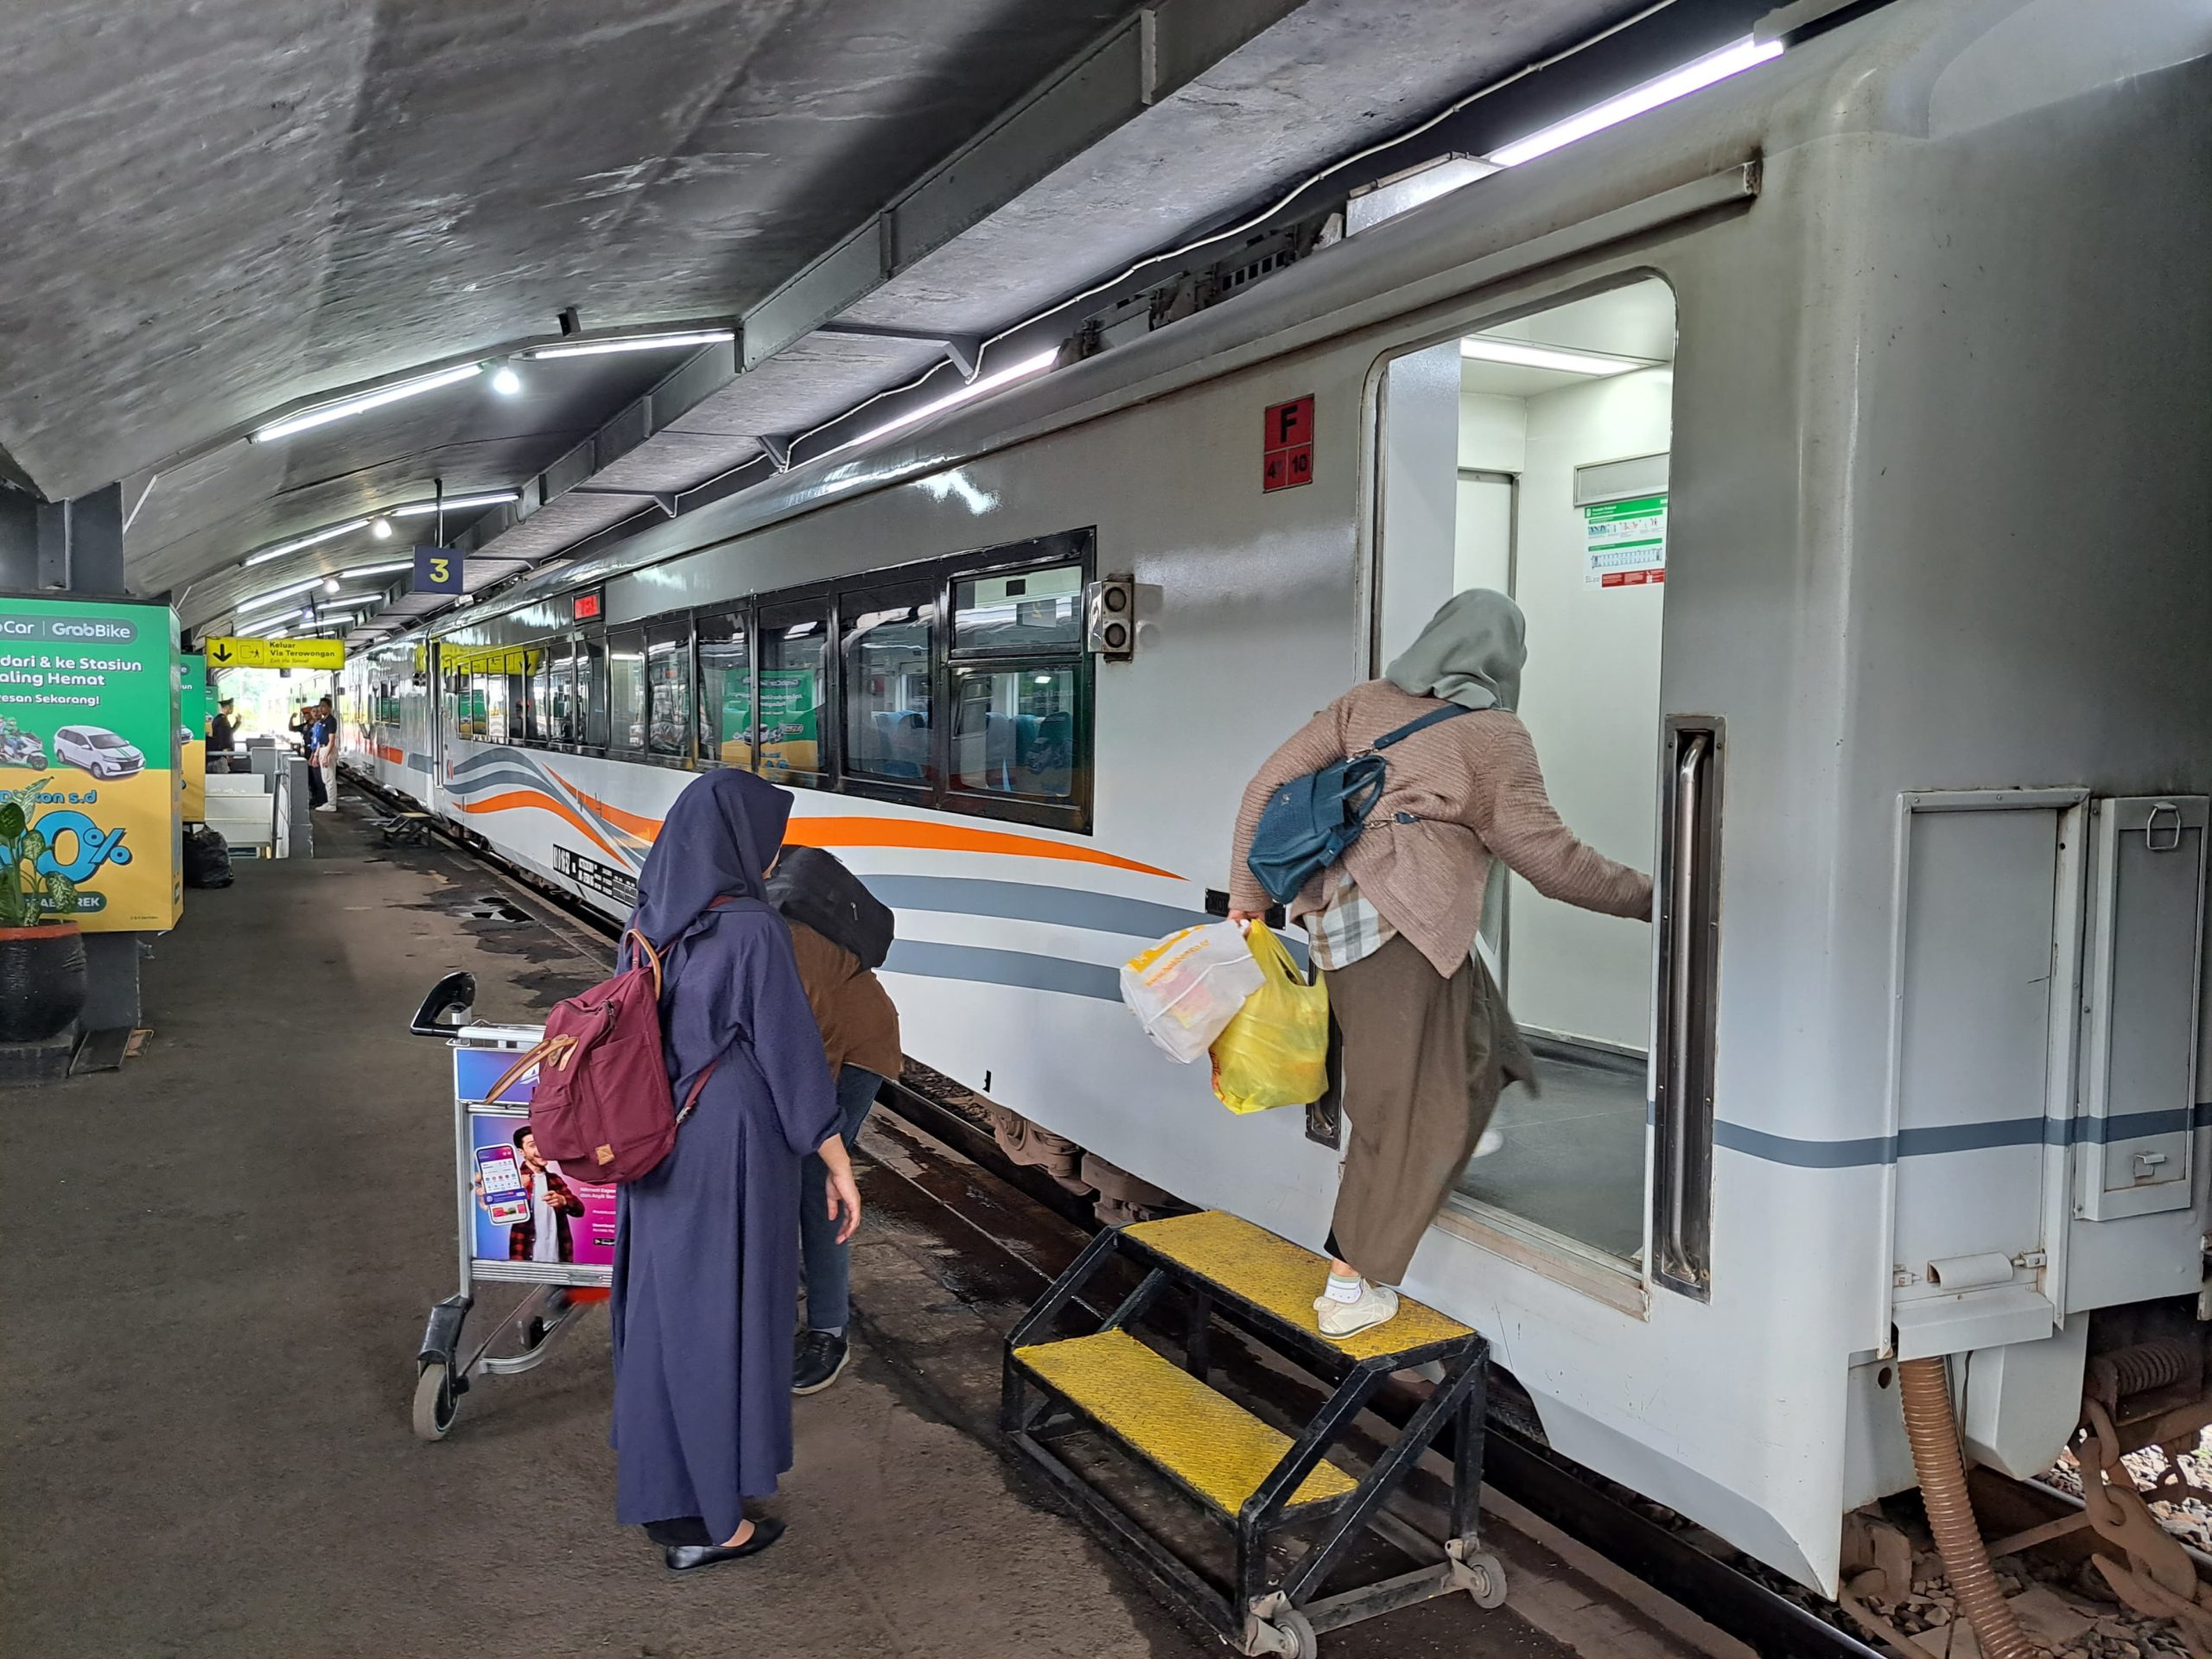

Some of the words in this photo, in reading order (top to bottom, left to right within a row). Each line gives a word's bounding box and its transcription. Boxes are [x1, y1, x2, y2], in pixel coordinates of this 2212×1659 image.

[1281, 405, 1298, 443] F
[1268, 461, 1276, 479] 4
[1292, 454, 1307, 474] 10
[429, 558, 450, 583] 3
[0, 620, 35, 634] Car
[52, 622, 130, 639] GrabBike
[0, 654, 35, 668] dari
[40, 656, 51, 669] &
[55, 656, 75, 670] ke
[79, 658, 143, 671] Stasiun
[48, 672, 105, 686] Hemat
[0, 694, 32, 703] esan
[35, 694, 99, 708] Sekarang!
[68, 790, 98, 804] s.d
